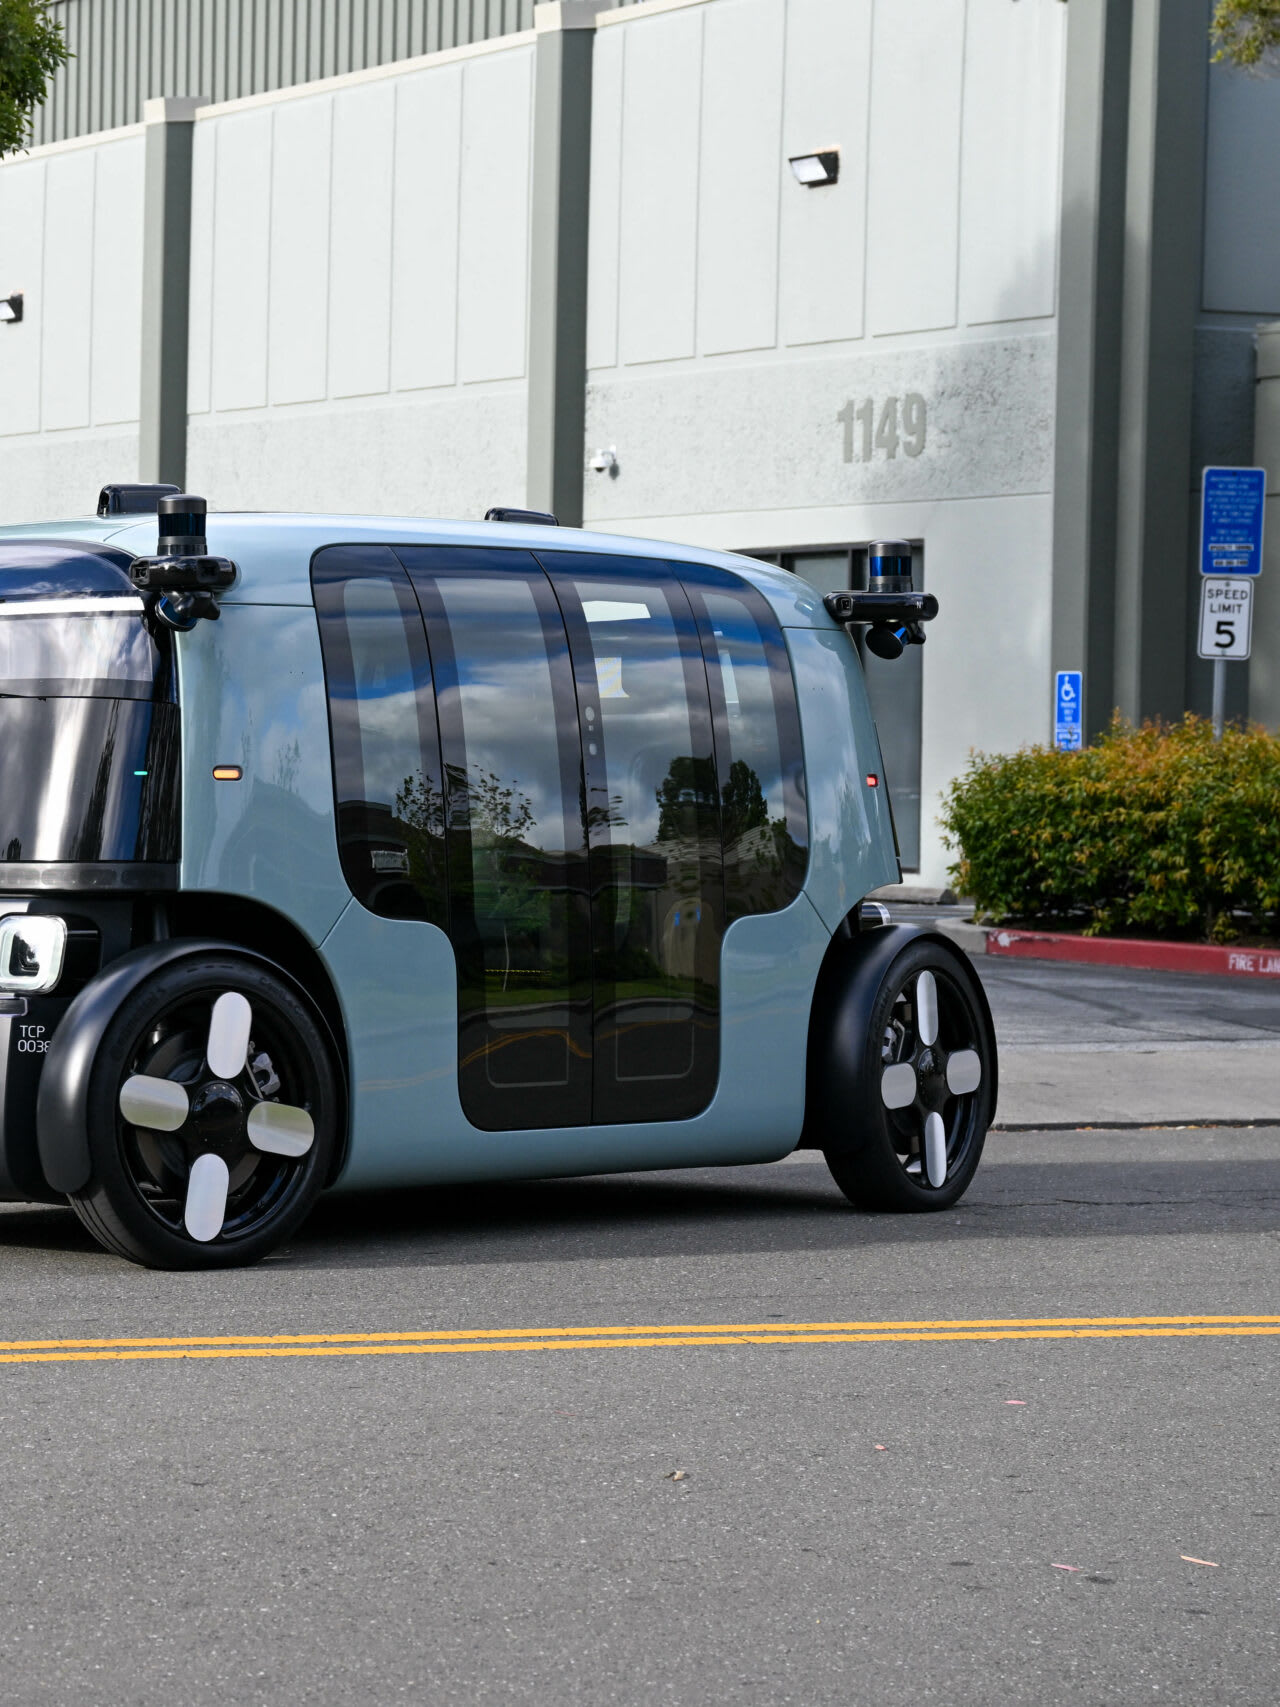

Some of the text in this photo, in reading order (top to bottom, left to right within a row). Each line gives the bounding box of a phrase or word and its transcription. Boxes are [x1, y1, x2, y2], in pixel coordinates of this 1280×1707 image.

[837, 392, 927, 463] 1149
[1207, 588, 1248, 600] SPEED
[1210, 604, 1243, 614] LIMIT
[1214, 621, 1236, 648] 5
[1228, 953, 1255, 971] FIRE
[19, 1025, 46, 1038] TCP
